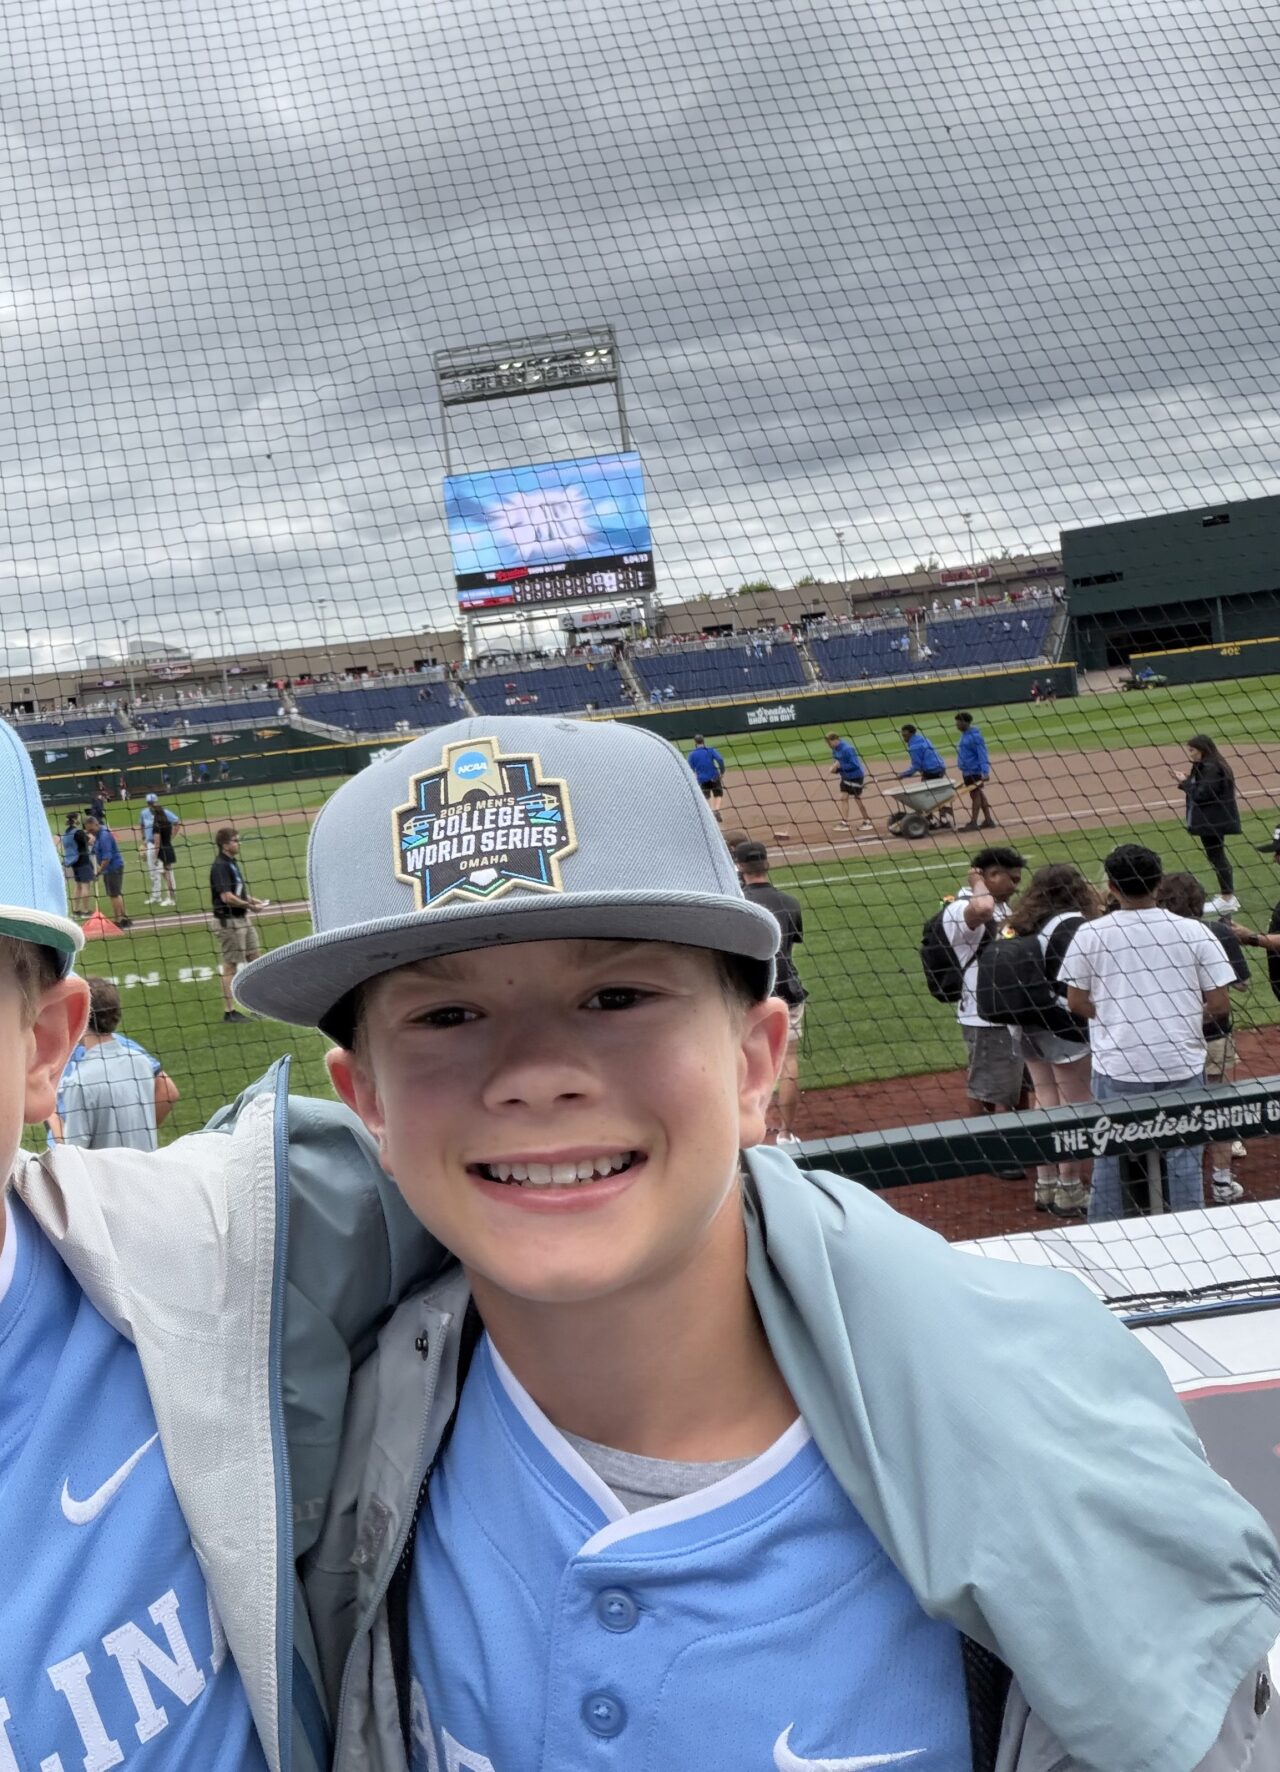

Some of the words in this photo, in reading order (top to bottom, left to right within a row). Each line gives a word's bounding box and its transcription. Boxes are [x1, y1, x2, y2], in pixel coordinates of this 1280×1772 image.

[458, 762, 487, 774] NCAA
[440, 803, 471, 818] 2026
[476, 797, 515, 810] MEN'S
[433, 805, 526, 840] COLLEGE
[406, 834, 476, 873] WORLD
[480, 826, 558, 853] SERIES
[460, 854, 508, 870] OMAHA
[1051, 1130, 1090, 1154] THE
[1088, 1104, 1202, 1156] Greatest
[1203, 1101, 1262, 1132] SHOW
